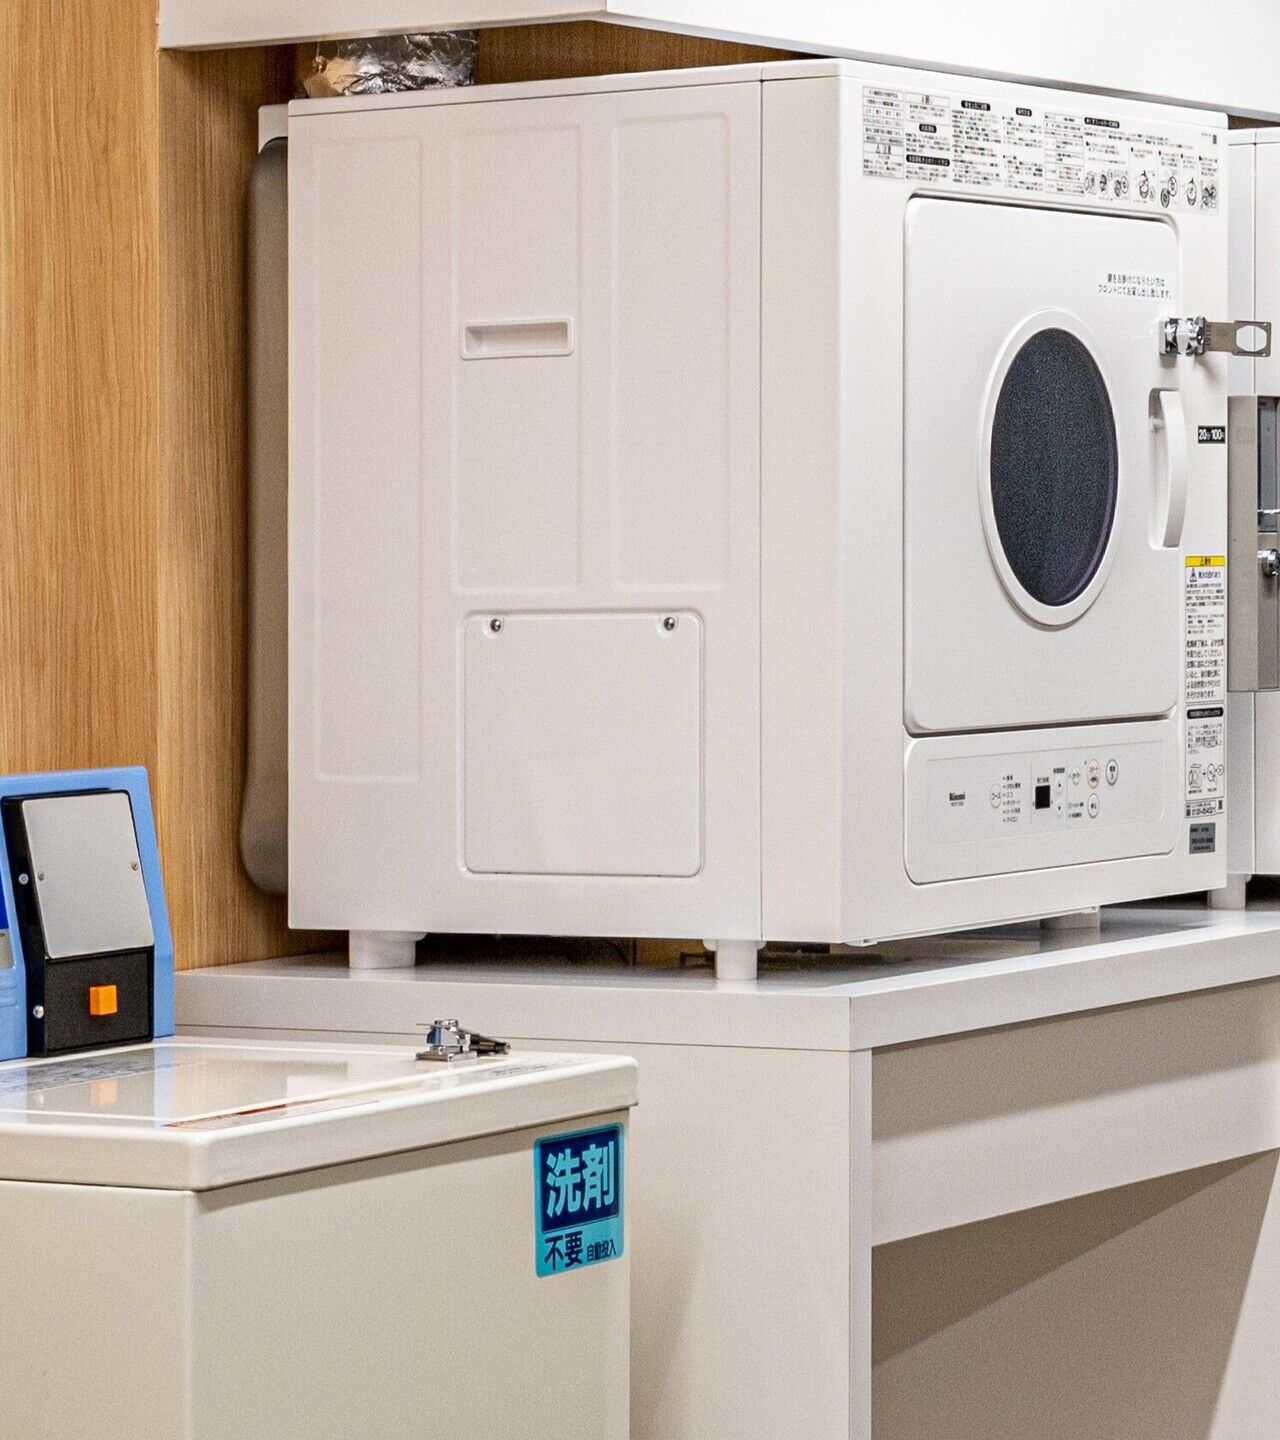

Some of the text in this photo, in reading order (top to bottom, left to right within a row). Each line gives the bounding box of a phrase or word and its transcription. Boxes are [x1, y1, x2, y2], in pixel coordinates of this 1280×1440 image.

[546, 1140, 615, 1218] 洗剤
[544, 1230, 617, 1270] 不要 自動投入
